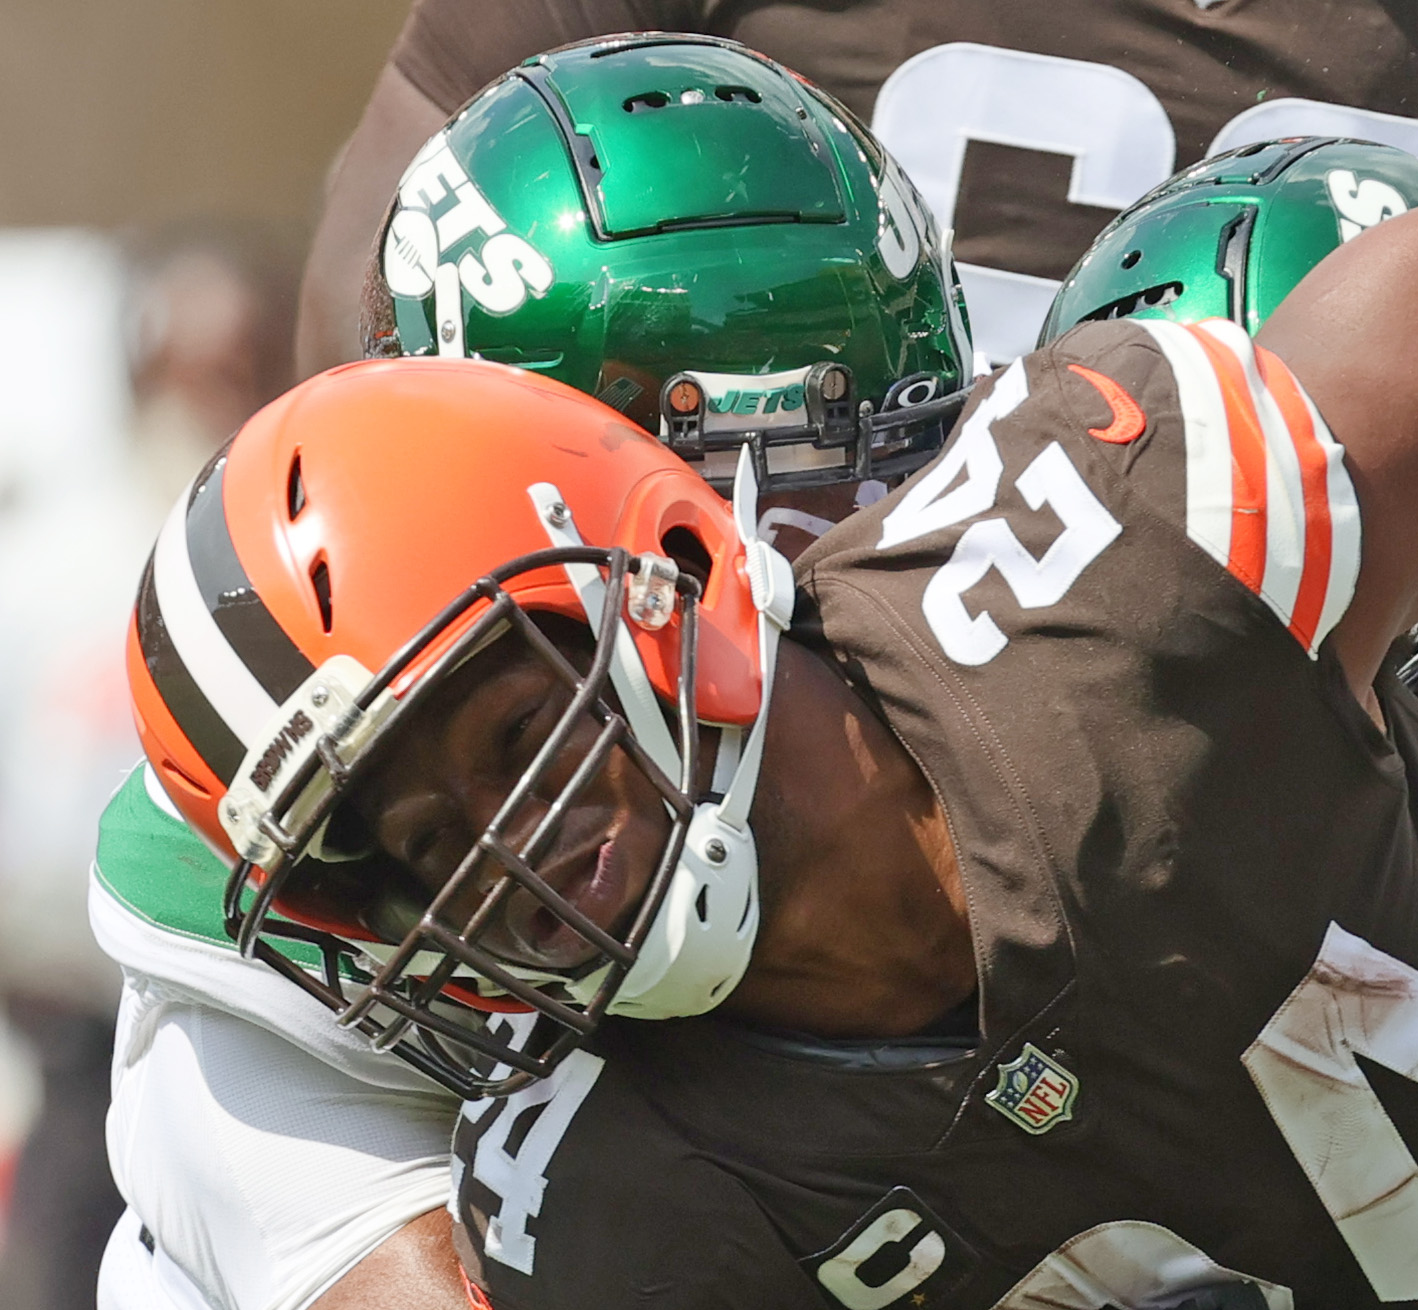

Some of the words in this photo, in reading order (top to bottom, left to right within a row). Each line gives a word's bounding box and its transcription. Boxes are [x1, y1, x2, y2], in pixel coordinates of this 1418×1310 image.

[707, 384, 804, 415] JETS
[875, 355, 1124, 666] 24
[249, 710, 314, 793] BROWNS
[1017, 1077, 1069, 1125] NFL
